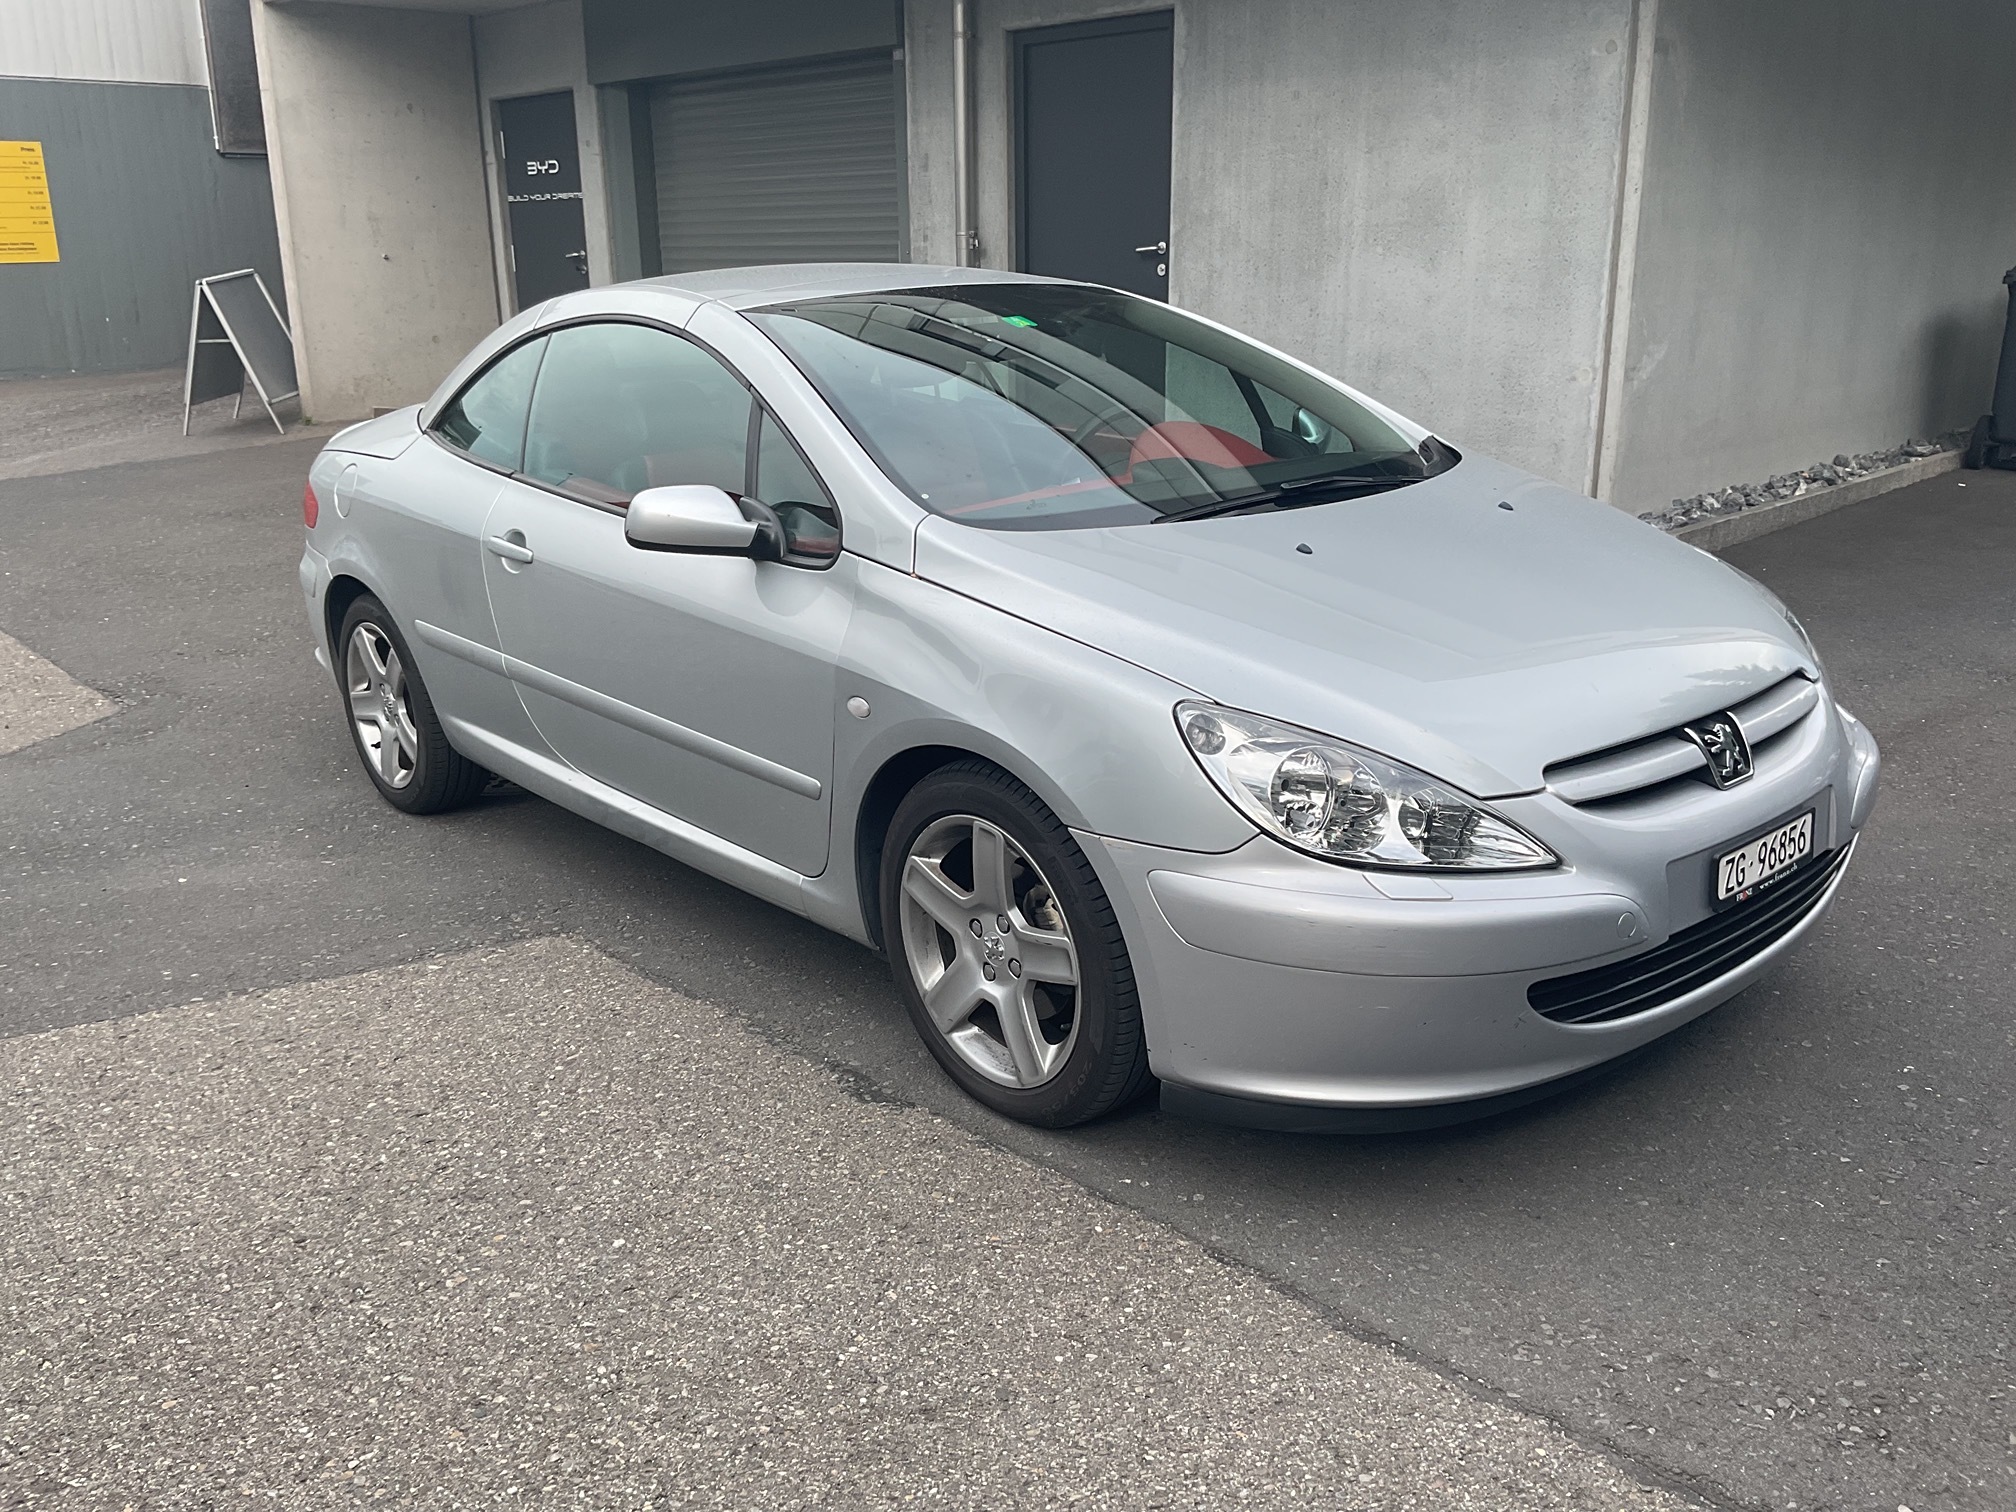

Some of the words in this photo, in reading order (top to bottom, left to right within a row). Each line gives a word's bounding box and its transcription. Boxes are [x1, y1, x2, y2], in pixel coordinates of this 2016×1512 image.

[526, 160, 560, 175] BYD
[530, 193, 551, 201] YOUR
[1725, 851, 1746, 895] ZG
[1758, 818, 1806, 877] 96856
[1759, 863, 1798, 890] www.franz.ch
